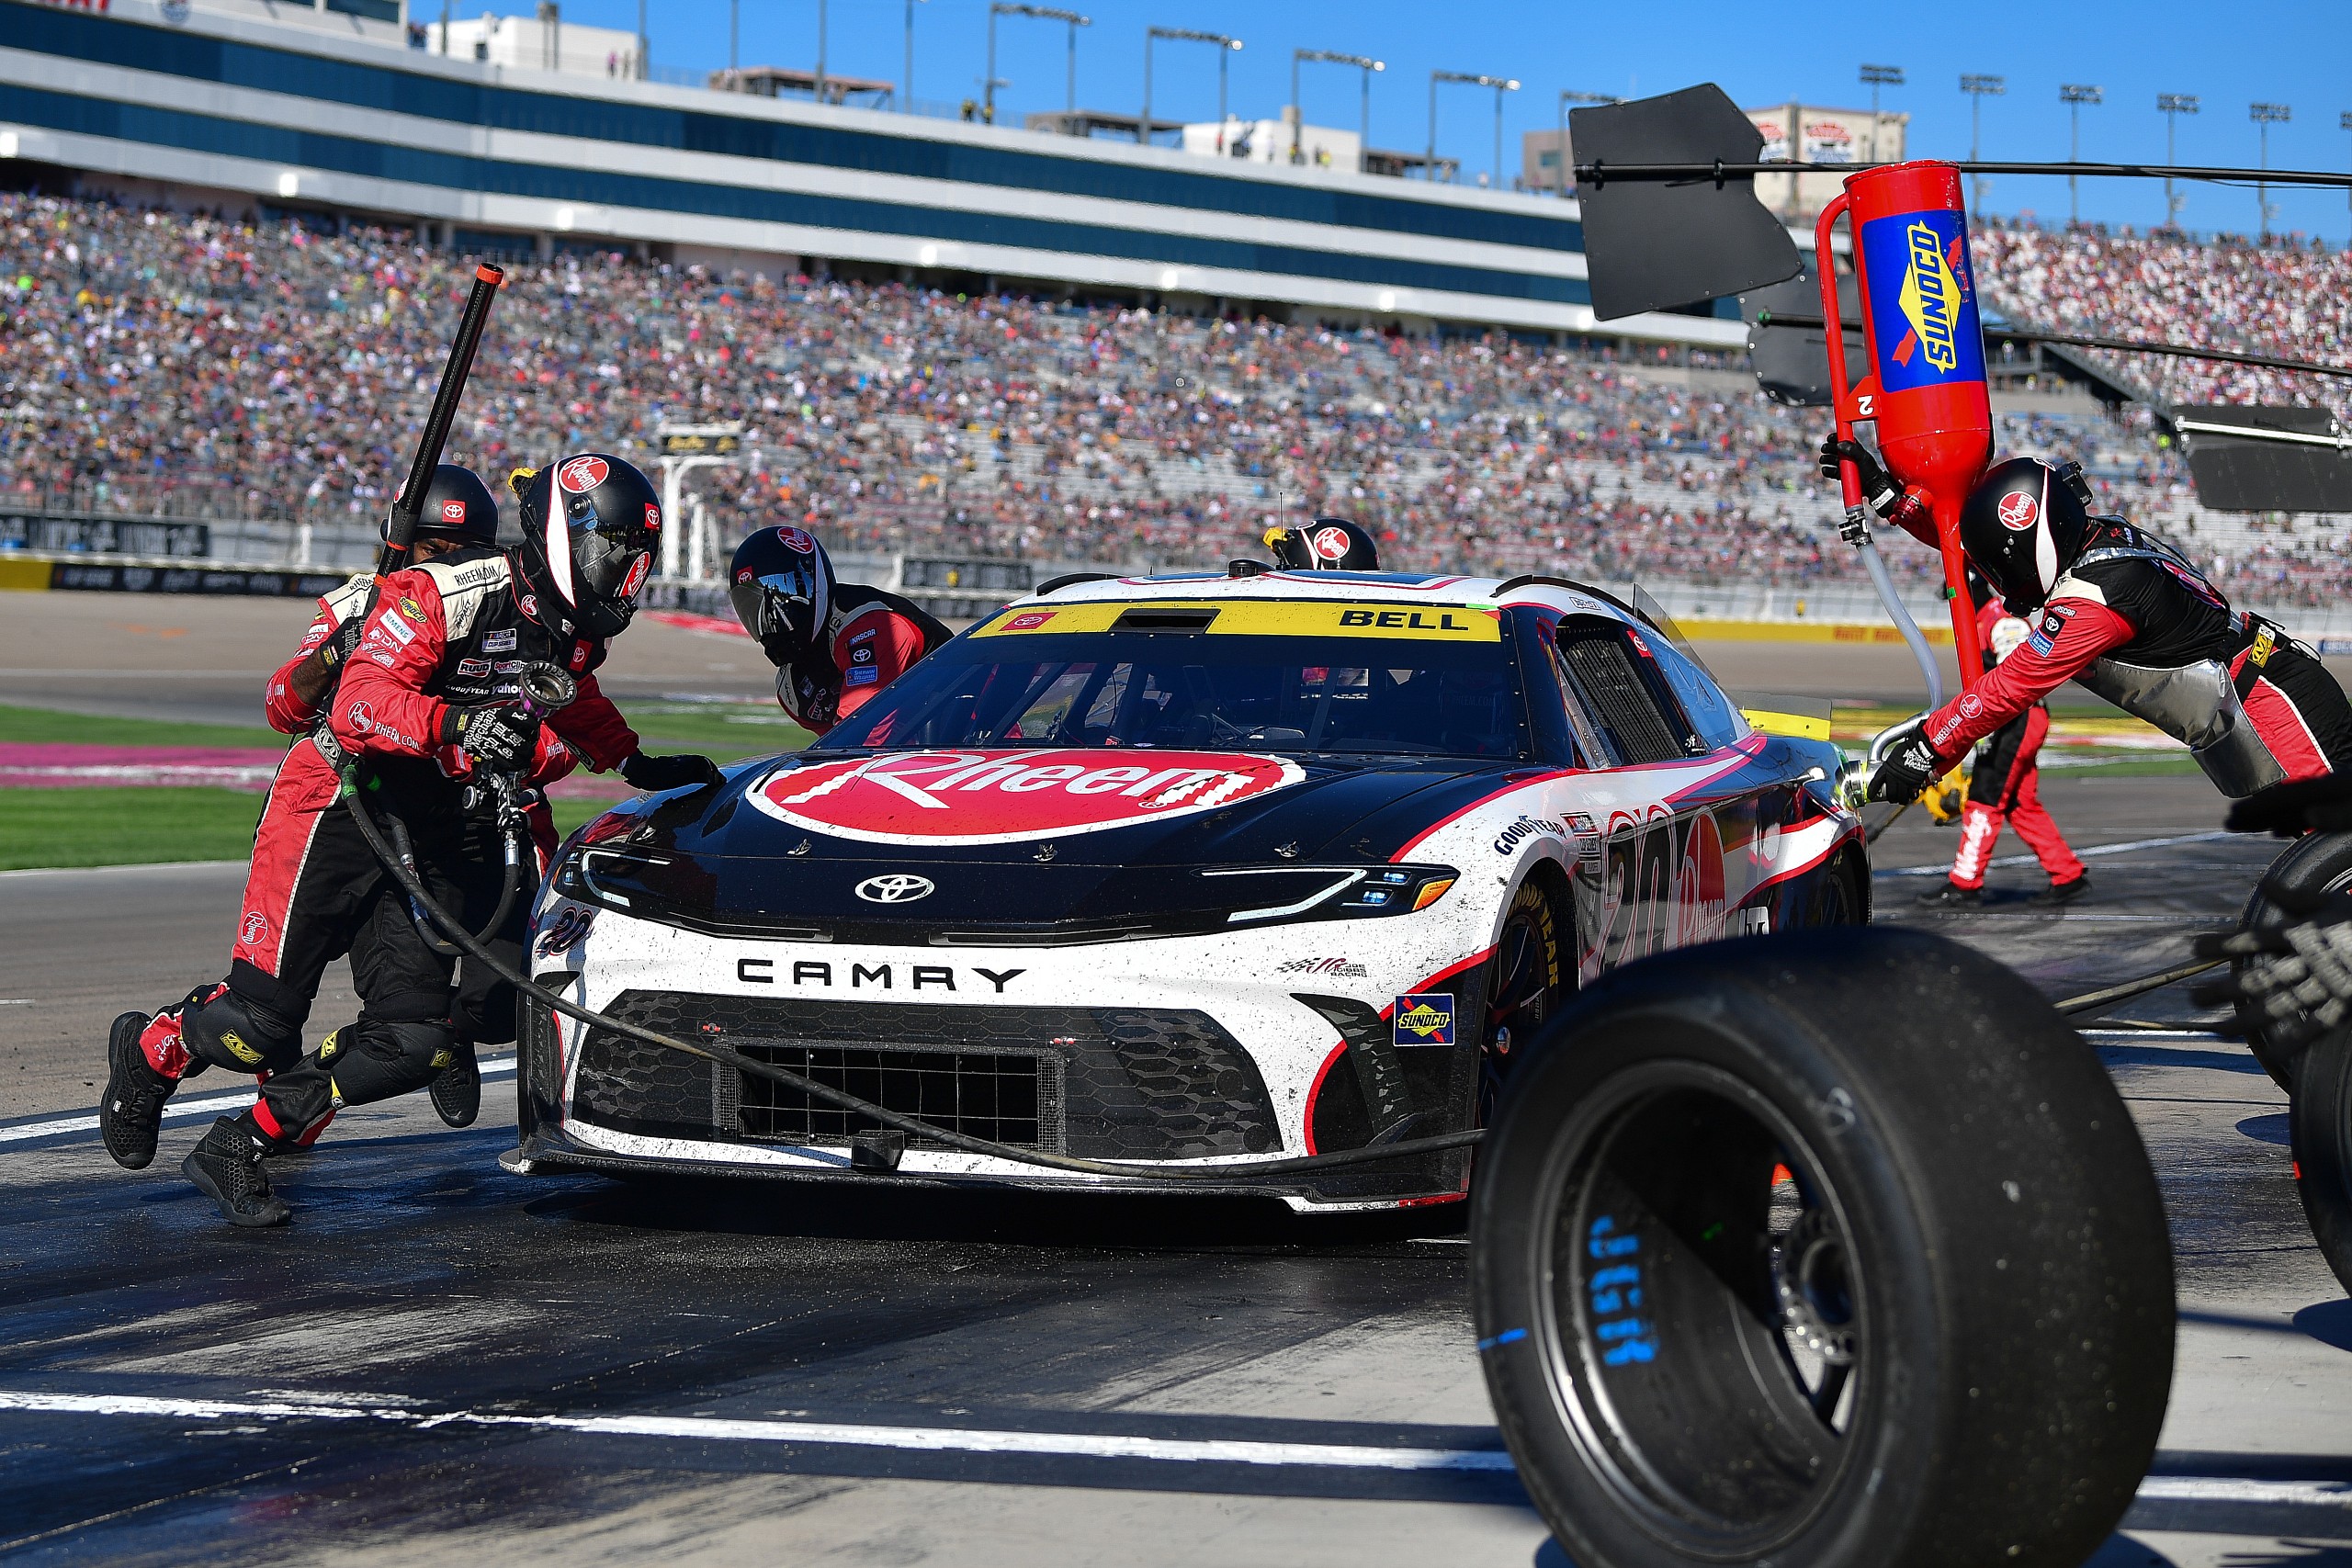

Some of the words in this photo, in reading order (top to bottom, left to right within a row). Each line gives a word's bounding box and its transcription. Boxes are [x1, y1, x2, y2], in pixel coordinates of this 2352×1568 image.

[1911, 230, 1953, 366] SUNOCO
[1857, 394, 1874, 416] 2
[563, 457, 604, 490] Rheem
[1998, 491, 2033, 527] Rheem
[1316, 528, 1346, 557] Rheem
[399, 596, 428, 623] SUNOCO
[1339, 610, 1469, 631] BELL
[384, 614, 409, 638] SIEMENS
[850, 628, 876, 645] NASCAR
[460, 662, 490, 673] RUUD
[495, 660, 526, 671] SportClip
[350, 703, 371, 730] Rheem
[1962, 697, 1982, 717] Rheem
[374, 721, 420, 750] RHEEM.COM
[1932, 713, 1963, 747] RHEEM.COM
[780, 750, 1256, 809] Rheem
[1494, 814, 1568, 857] GOODYEAR
[243, 914, 267, 942] Rheem
[536, 906, 594, 956] 20
[737, 958, 1027, 993] CAMRY
[1399, 1013, 1449, 1028] SUNOCO
